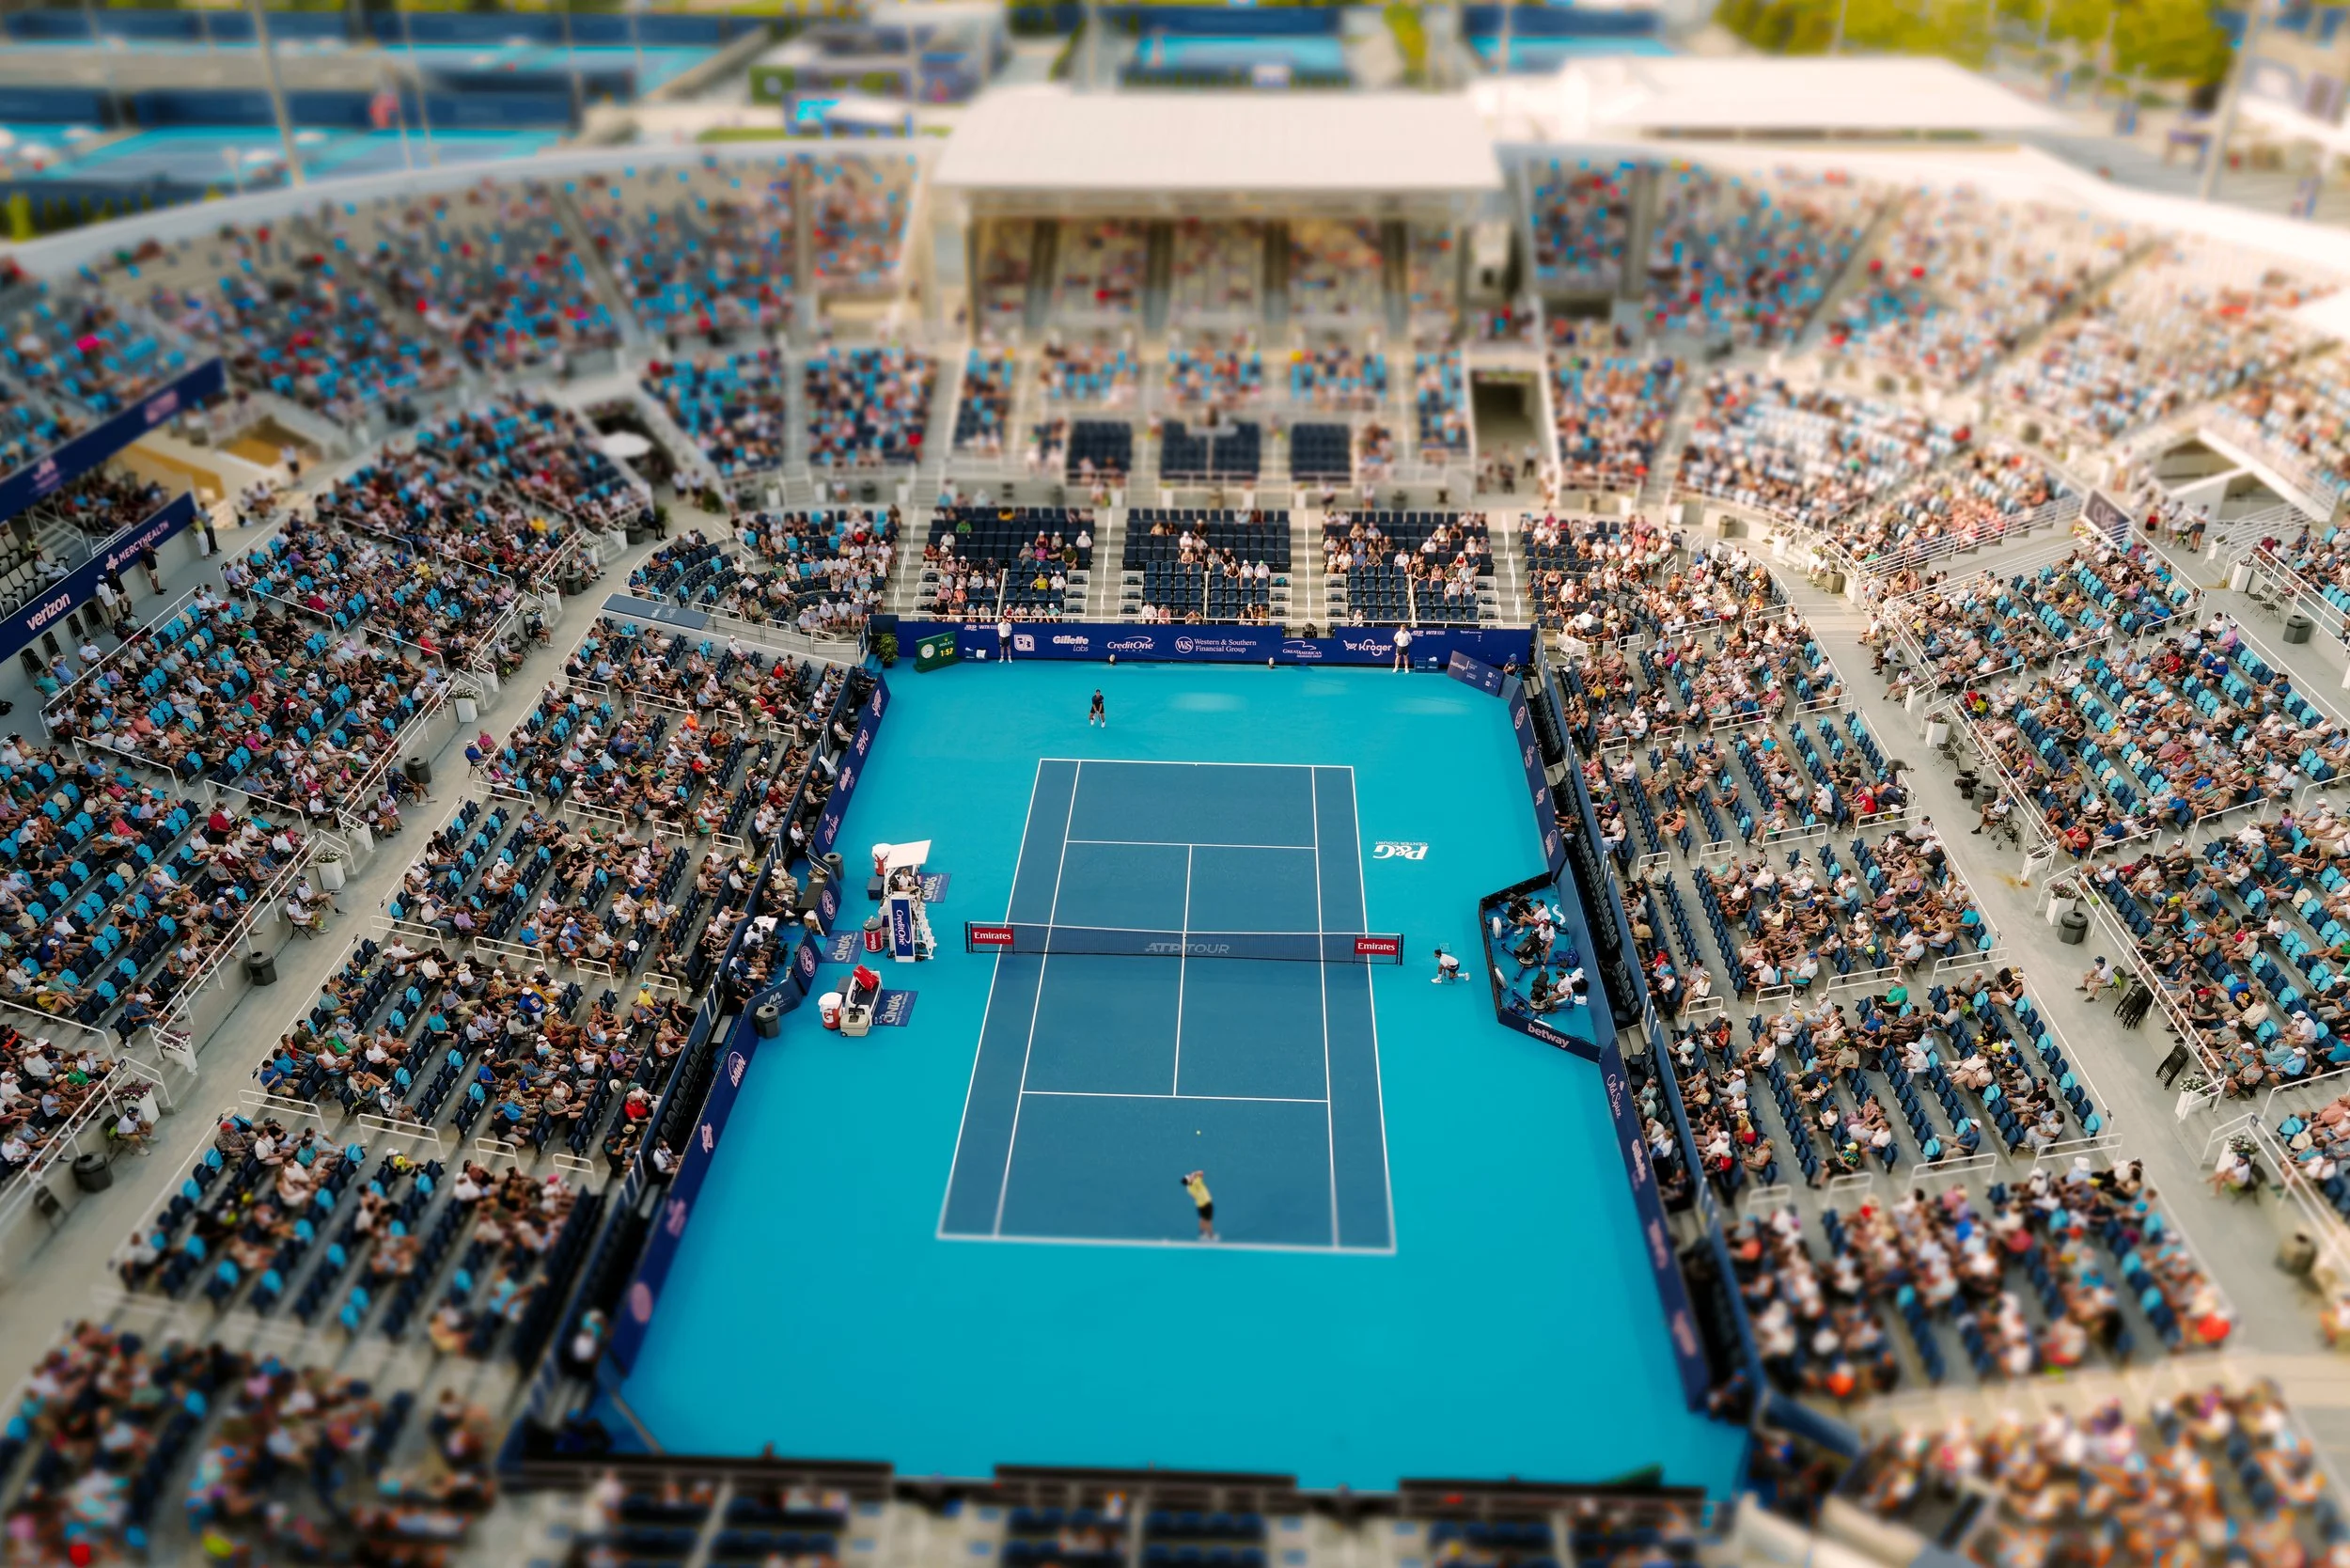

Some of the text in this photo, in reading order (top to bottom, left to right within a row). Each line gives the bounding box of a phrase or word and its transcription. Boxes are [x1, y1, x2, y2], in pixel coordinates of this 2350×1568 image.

[118, 521, 170, 562] MERCYHEALTH
[26, 593, 71, 631] verizon
[1053, 635, 1089, 644] Gillette
[1358, 639, 1392, 656] Kroger
[1225, 645, 1246, 653] Group
[1372, 844, 1429, 860] P&G
[974, 932, 1011, 940] Emirates
[1145, 942, 1230, 954] ATP TOUR
[1357, 942, 1396, 951] Emirates
[1528, 1023, 1570, 1048] betway
[731, 1058, 746, 1088] DAWN
